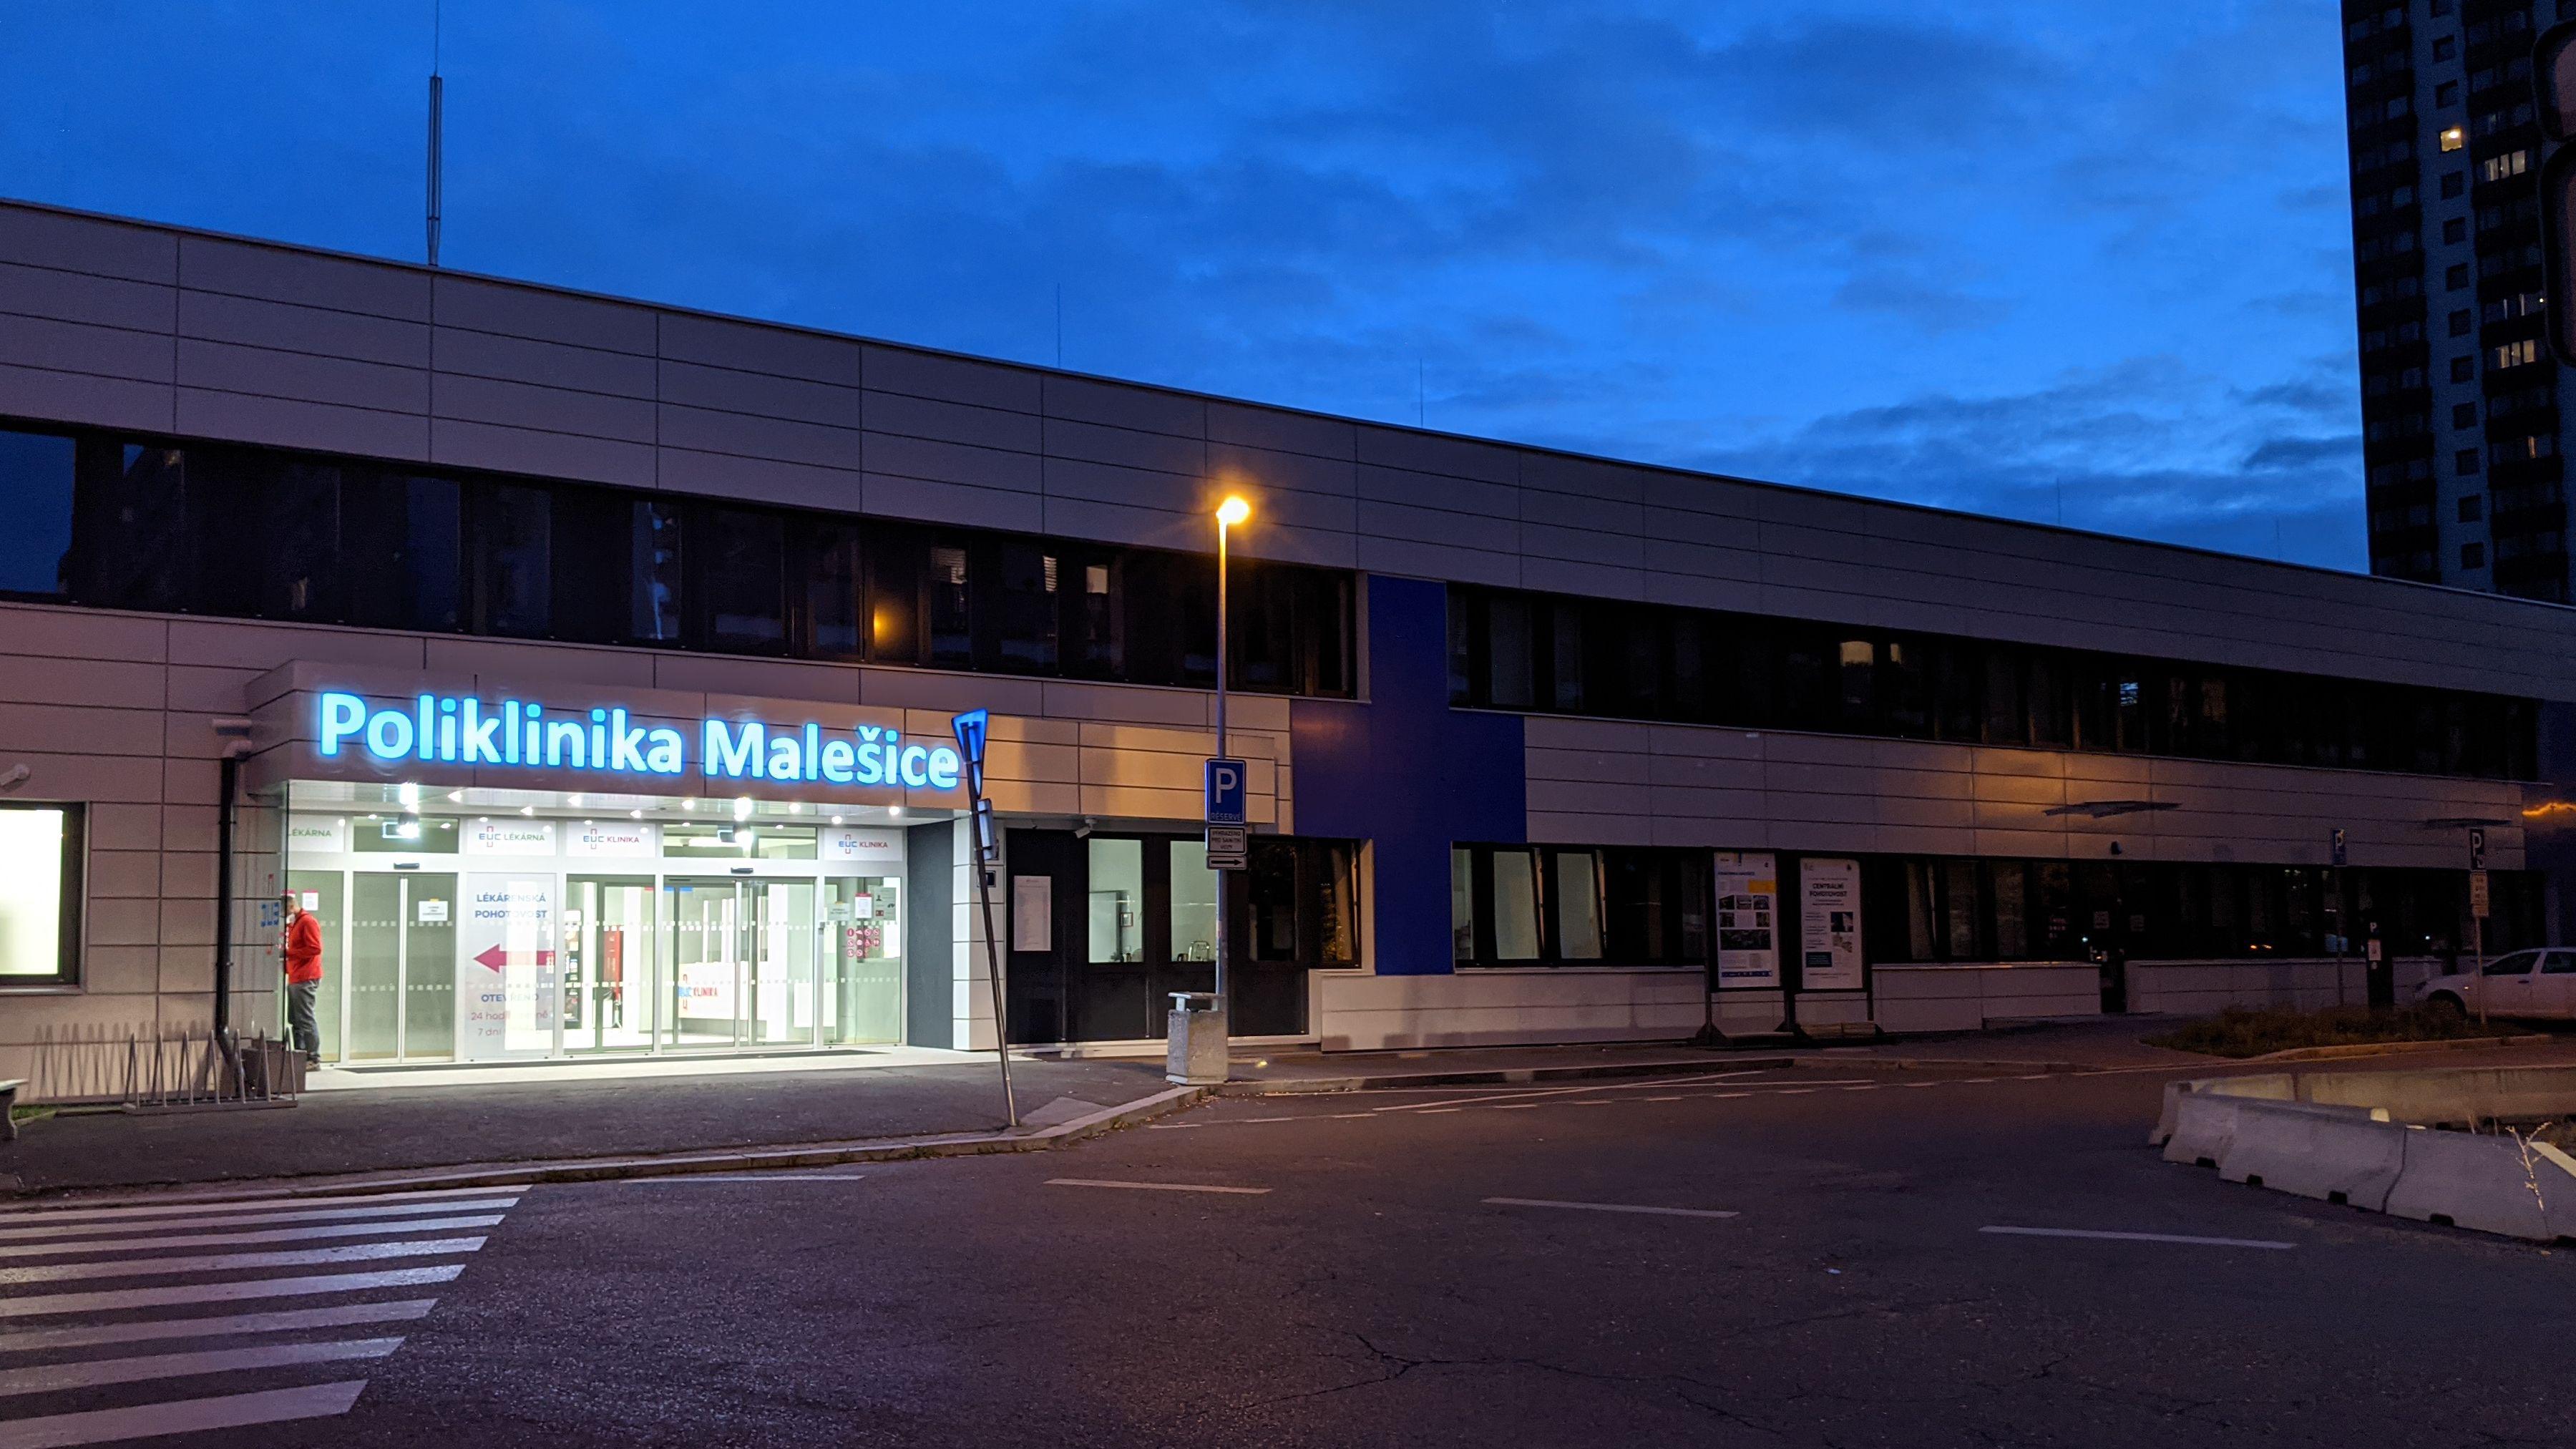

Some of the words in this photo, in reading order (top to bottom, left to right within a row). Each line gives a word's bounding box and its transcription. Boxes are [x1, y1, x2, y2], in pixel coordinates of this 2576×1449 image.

[321, 692, 682, 774] Poliklinika
[705, 719, 960, 789] Malešice
[1216, 768, 1237, 804] P
[504, 831, 545, 841] LÉKÁRNA
[2472, 831, 2482, 857] P
